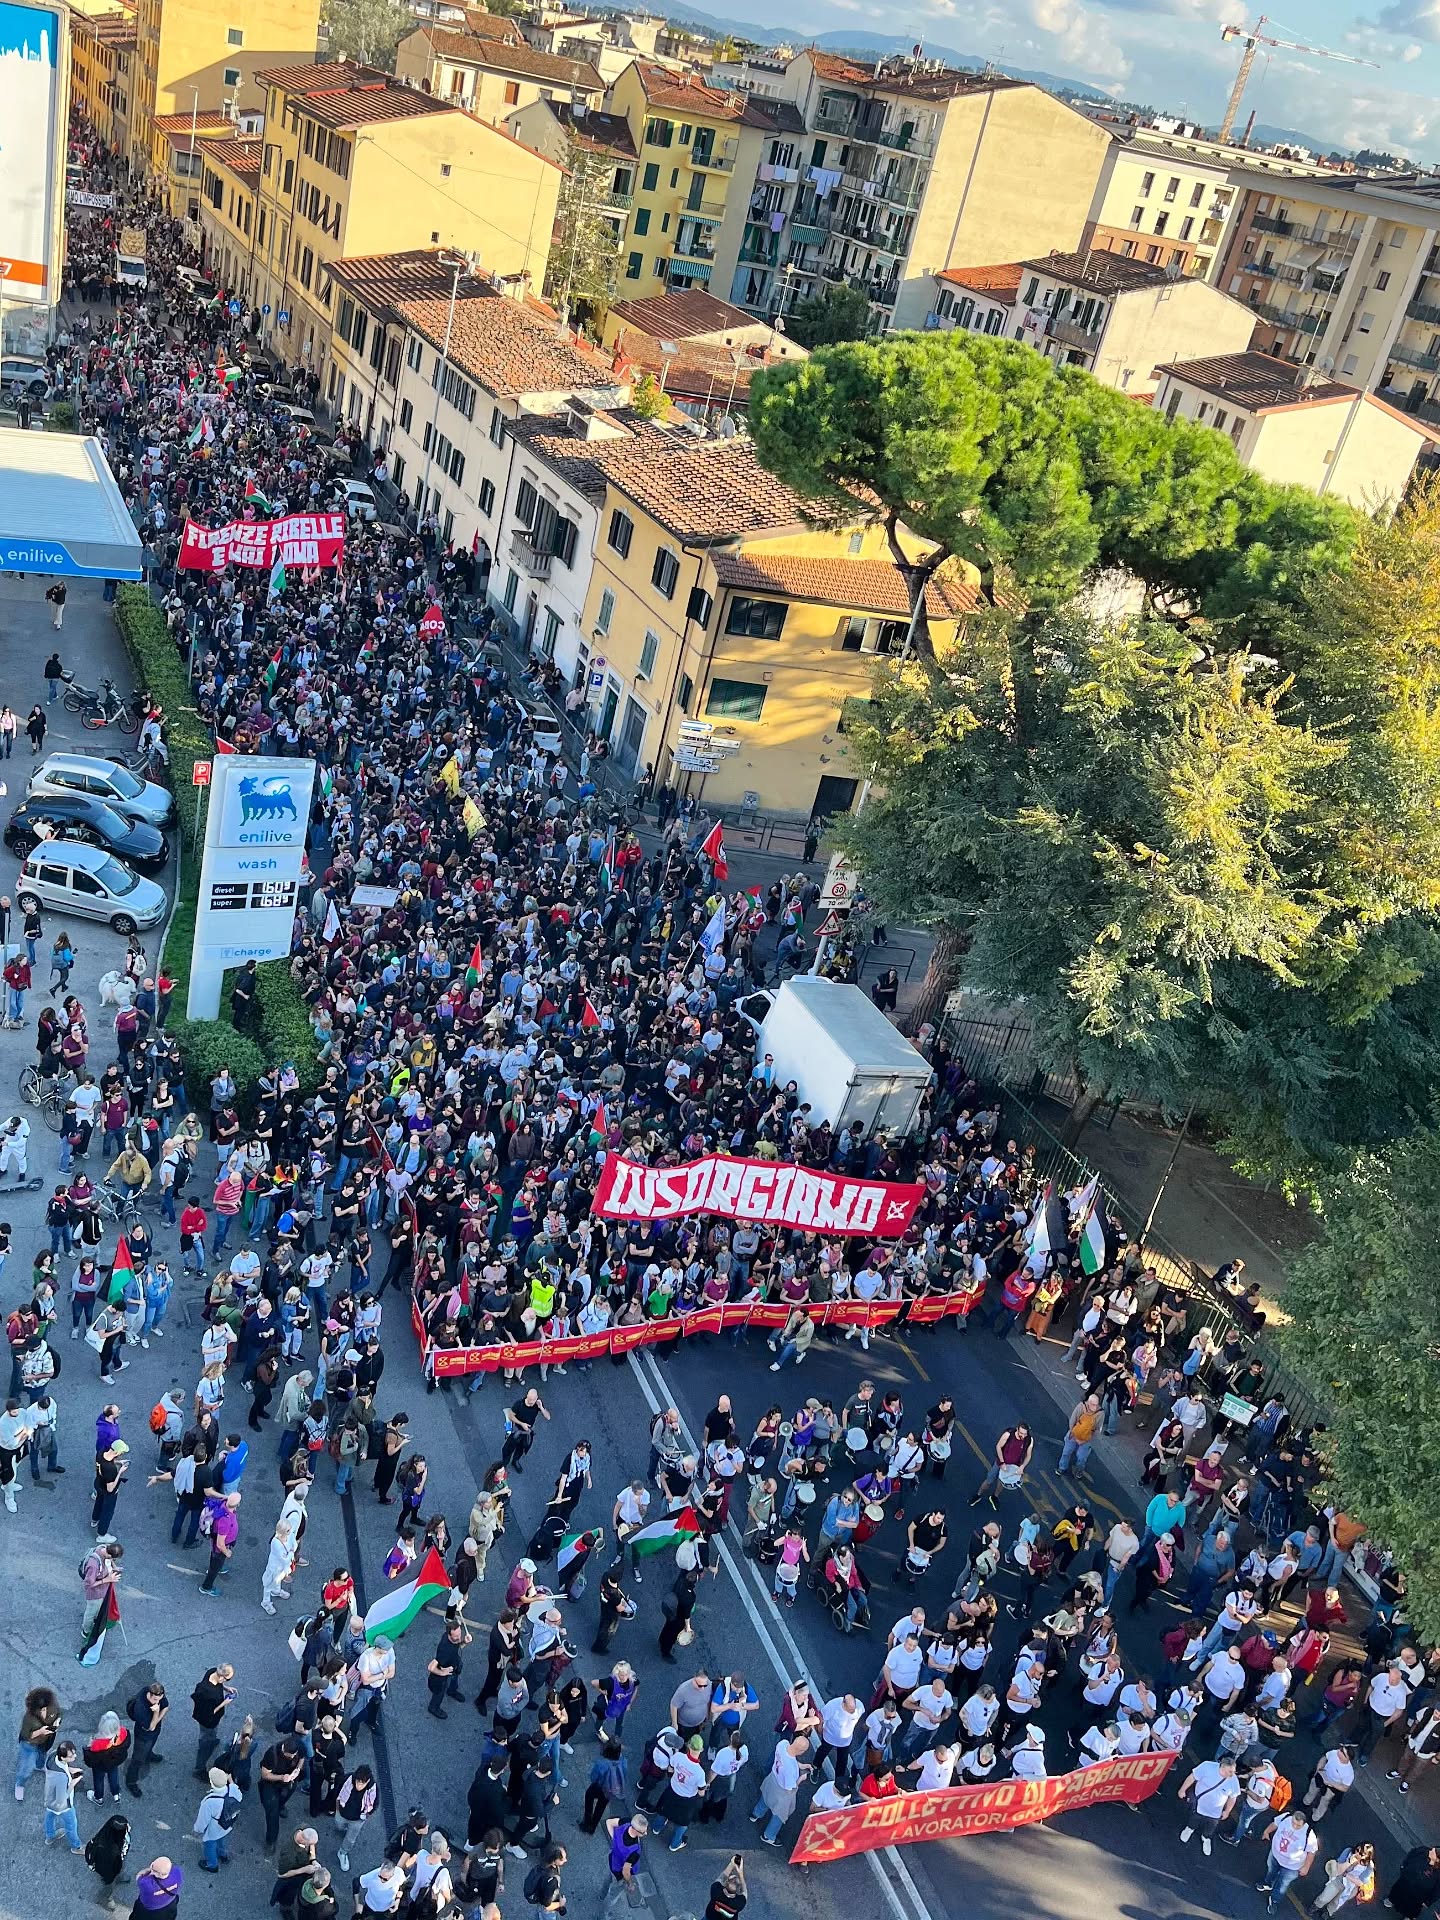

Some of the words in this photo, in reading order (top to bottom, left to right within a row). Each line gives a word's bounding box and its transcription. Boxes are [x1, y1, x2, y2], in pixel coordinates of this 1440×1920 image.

[186, 523, 268, 549] FIRENZE
[270, 516, 343, 544] RIBELLE
[7, 548, 64, 564] enilive
[211, 546, 226, 567] E
[228, 542, 264, 566] MAI
[592, 674, 602, 684] P
[197, 765, 207, 775] P
[239, 830, 293, 843] enilive
[238, 858, 278, 870] wash
[214, 886, 236, 895] diesel
[212, 900, 233, 908] super
[234, 947, 272, 957] charge
[603, 1158, 887, 1232] INSORGIAMO
[861, 1784, 1016, 1829] COLLETTIVO
[1021, 1780, 1047, 1806] DI
[890, 1812, 1009, 1841] LAVORATORI
[1012, 1803, 1050, 1822] GKN
[1053, 1783, 1126, 1812] FIRENZE
